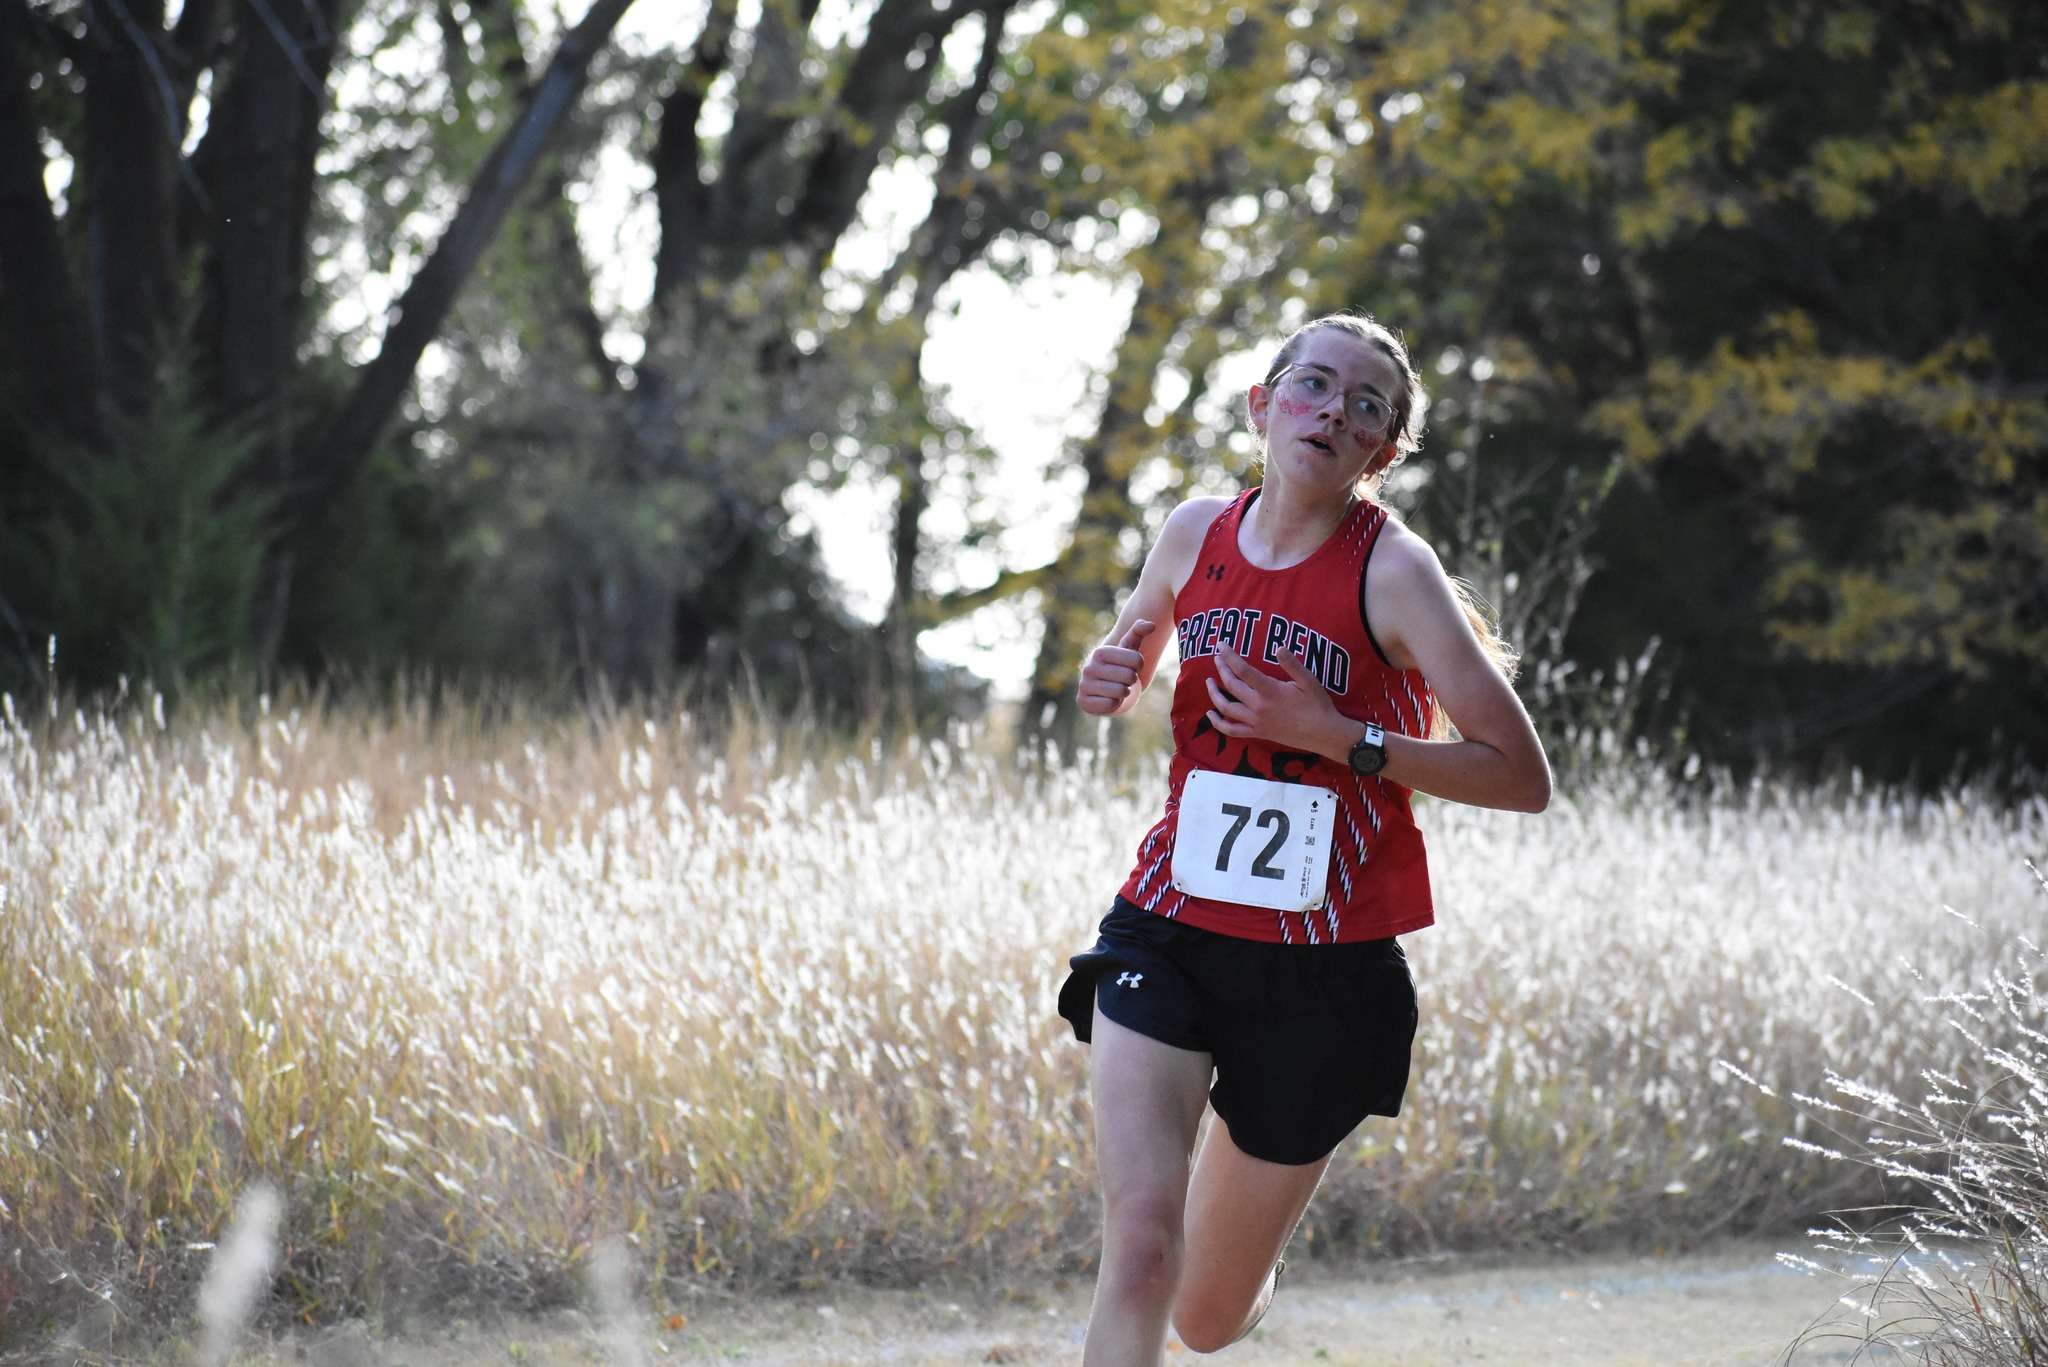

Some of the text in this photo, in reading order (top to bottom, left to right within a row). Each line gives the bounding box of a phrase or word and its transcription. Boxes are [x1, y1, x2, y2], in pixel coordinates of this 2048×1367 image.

[1178, 608, 1351, 696] GREAT BEND
[1215, 802, 1290, 880] 72
